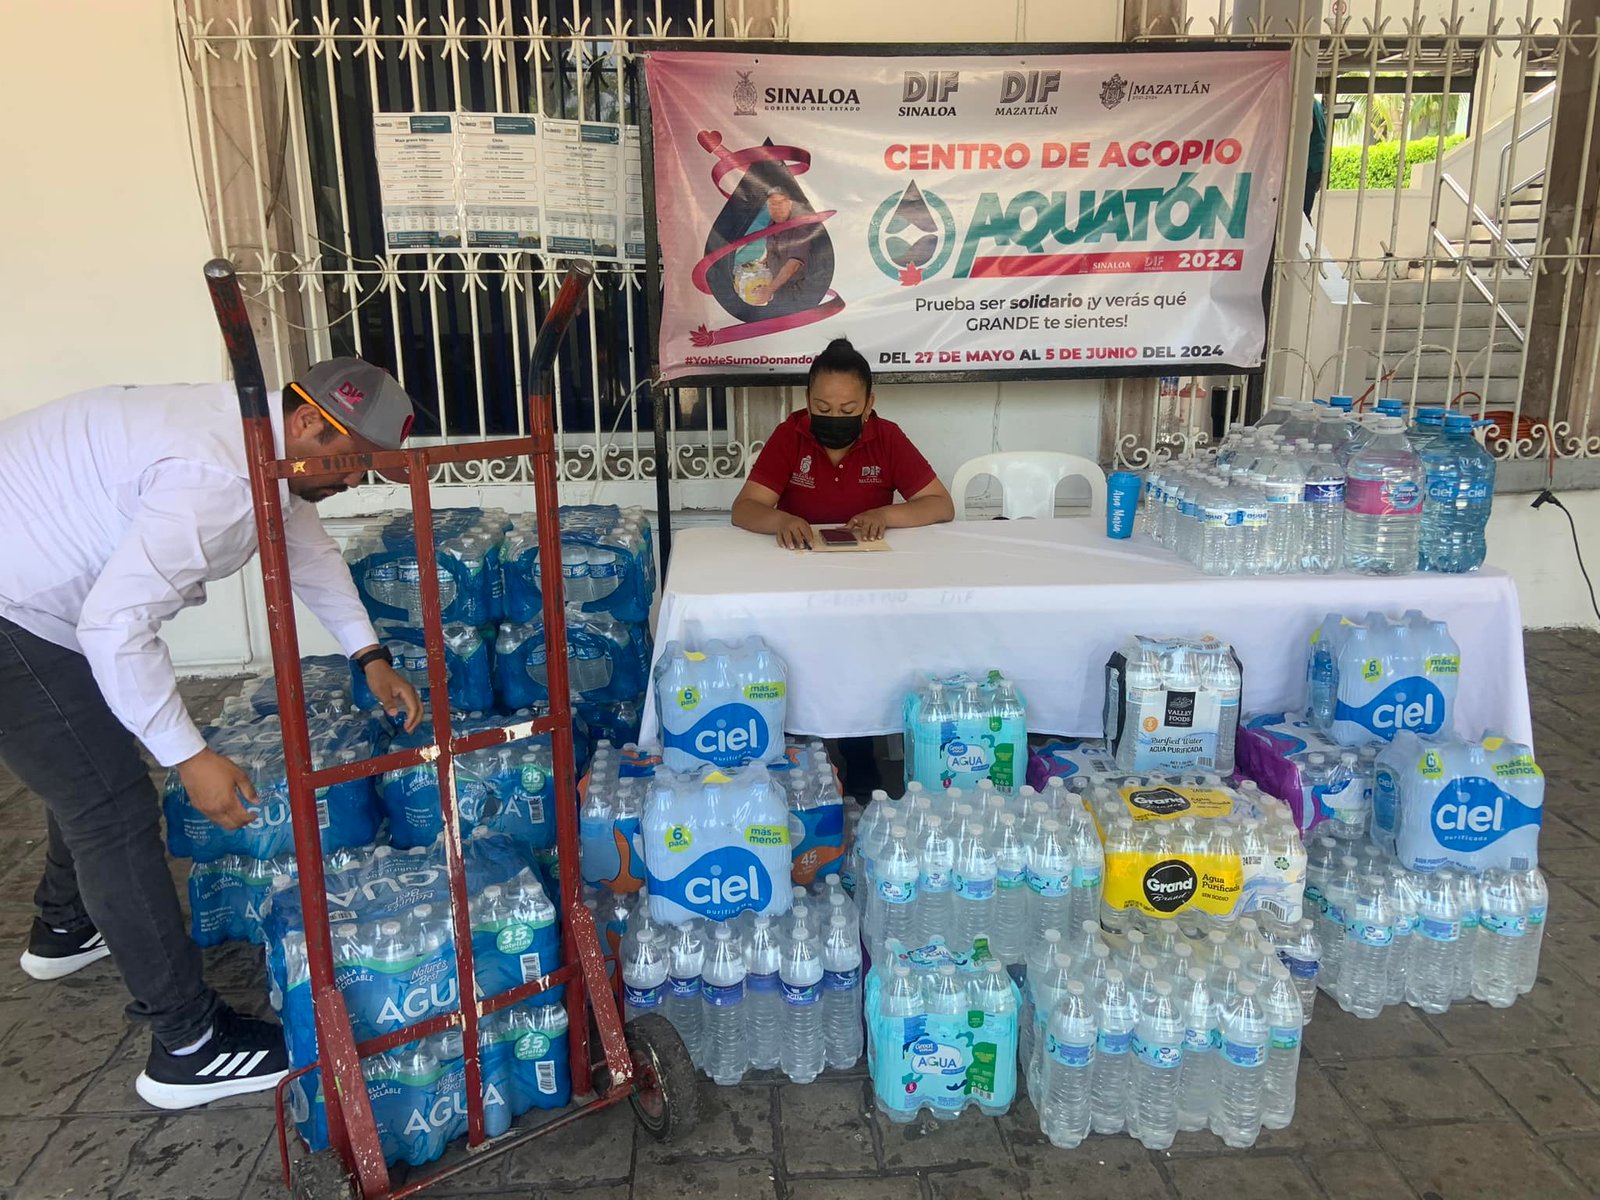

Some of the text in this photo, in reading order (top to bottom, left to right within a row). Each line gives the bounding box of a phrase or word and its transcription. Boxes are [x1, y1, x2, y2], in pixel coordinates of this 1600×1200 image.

[902, 70, 960, 103] DIF
[999, 69, 1062, 103] DIF
[1133, 80, 1211, 95] MAZATLÁN
[764, 87, 861, 105] SINALOA
[898, 106, 957, 117] SINALOA
[995, 104, 1059, 116] MAZATLÁN
[884, 137, 1243, 171] CENTRO DE ACOPIO
[953, 172, 1252, 279] AQUATÓN
[1092, 252, 1237, 270] SINALOA DIF 2024
[915, 291, 1187, 312] Prueba ser solidario ¡y verás qué
[966, 314, 1128, 332] GRANDE te sientes!
[878, 344, 1225, 364] DEL 27 DE MAYO AL 5 DE JUNIO DEL 2024
[1430, 484, 1453, 498] ciel
[1467, 485, 1487, 498] ciel
[1369, 660, 1377, 672] 6
[684, 688, 693, 700] 6
[749, 691, 778, 699] menos
[680, 697, 697, 706] pack
[1372, 691, 1434, 729] ciel
[219, 730, 338, 745] AGA
[695, 718, 758, 753] ciel
[1151, 736, 1204, 746] Purified Water
[1167, 746, 1203, 754] PURIFICADA
[951, 756, 983, 767] AGUA
[1426, 752, 1436, 768] 6
[1496, 758, 1522, 770] más
[524, 772, 540, 783] 35
[1422, 767, 1441, 775] pack
[1496, 766, 1536, 777] menos
[1435, 792, 1504, 832] ciel
[672, 827, 682, 840] 6
[751, 827, 772, 836] más
[668, 839, 688, 848] pack
[749, 835, 782, 844] menos
[801, 850, 817, 865] 45
[684, 865, 760, 905] ciel
[1146, 877, 1193, 893] Grand
[1201, 873, 1225, 884] Agua
[326, 866, 446, 907] GUA
[1150, 891, 1187, 902] Brand
[502, 927, 528, 944] 35
[500, 939, 531, 951] botellas
[411, 959, 449, 980] Nature's
[418, 971, 438, 986] Best
[786, 993, 803, 1001] AGUA
[520, 1036, 543, 1052] 35
[917, 1056, 957, 1068] AGUA
[437, 1071, 466, 1090] Nature
[442, 1080, 463, 1094] Best
[367, 1082, 387, 1094] ELLA
[369, 1087, 401, 1101] CICLABLE
